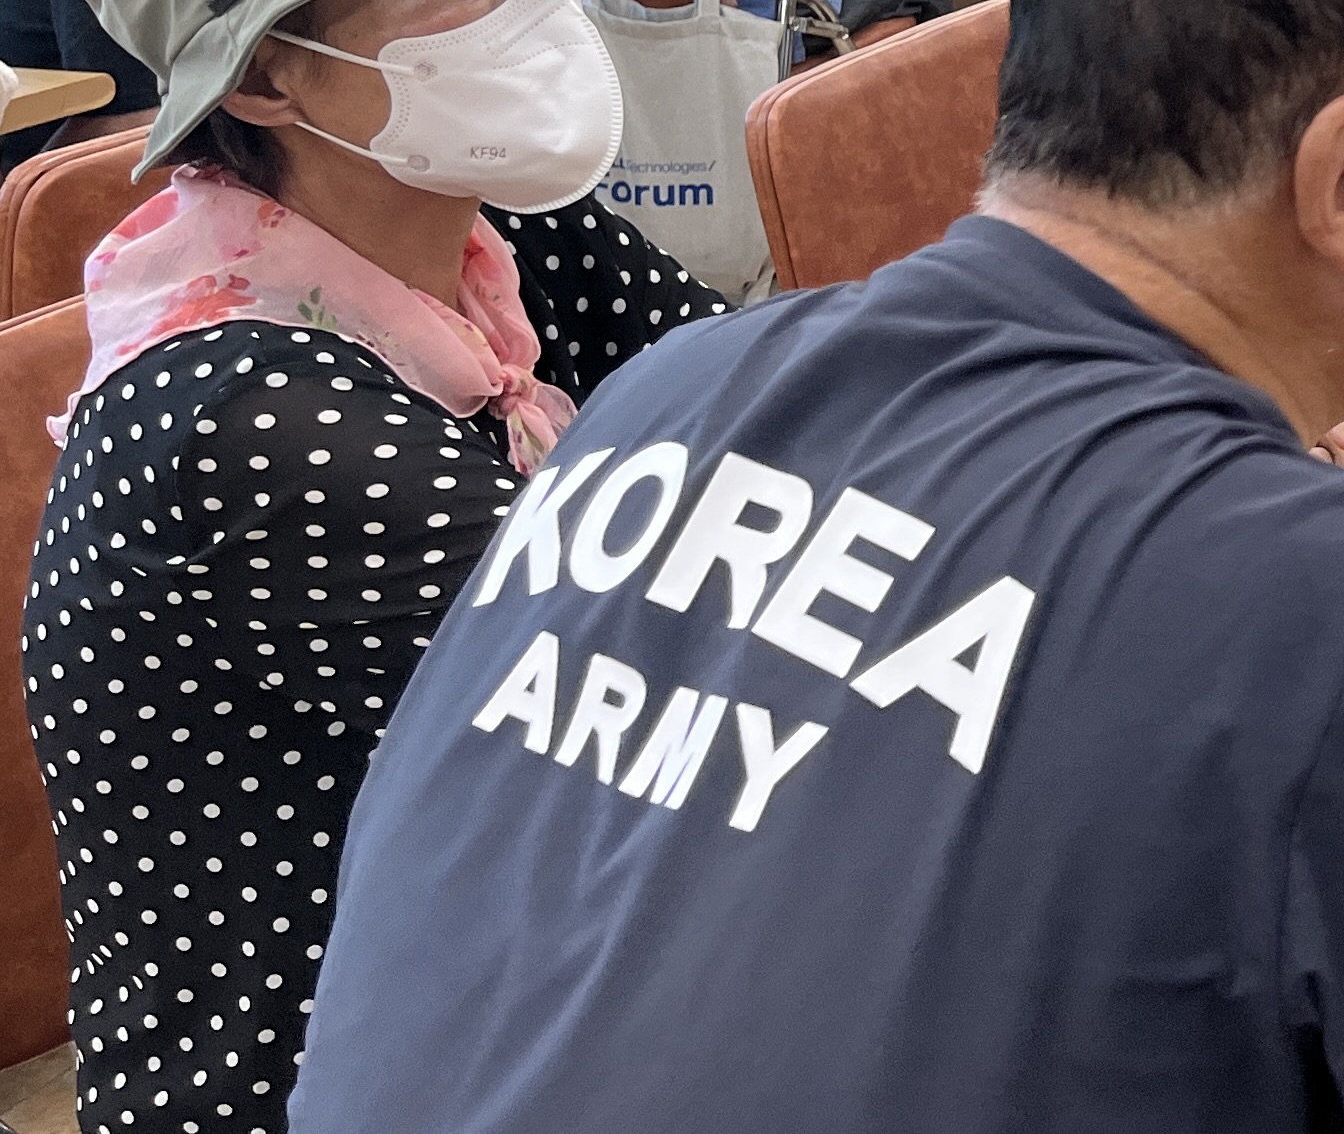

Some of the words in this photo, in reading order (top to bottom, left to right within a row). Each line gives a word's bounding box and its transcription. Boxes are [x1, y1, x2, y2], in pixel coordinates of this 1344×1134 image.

[470, 146, 507, 161] KF94
[472, 441, 1036, 775] KOREA
[472, 630, 830, 834] ARMY
